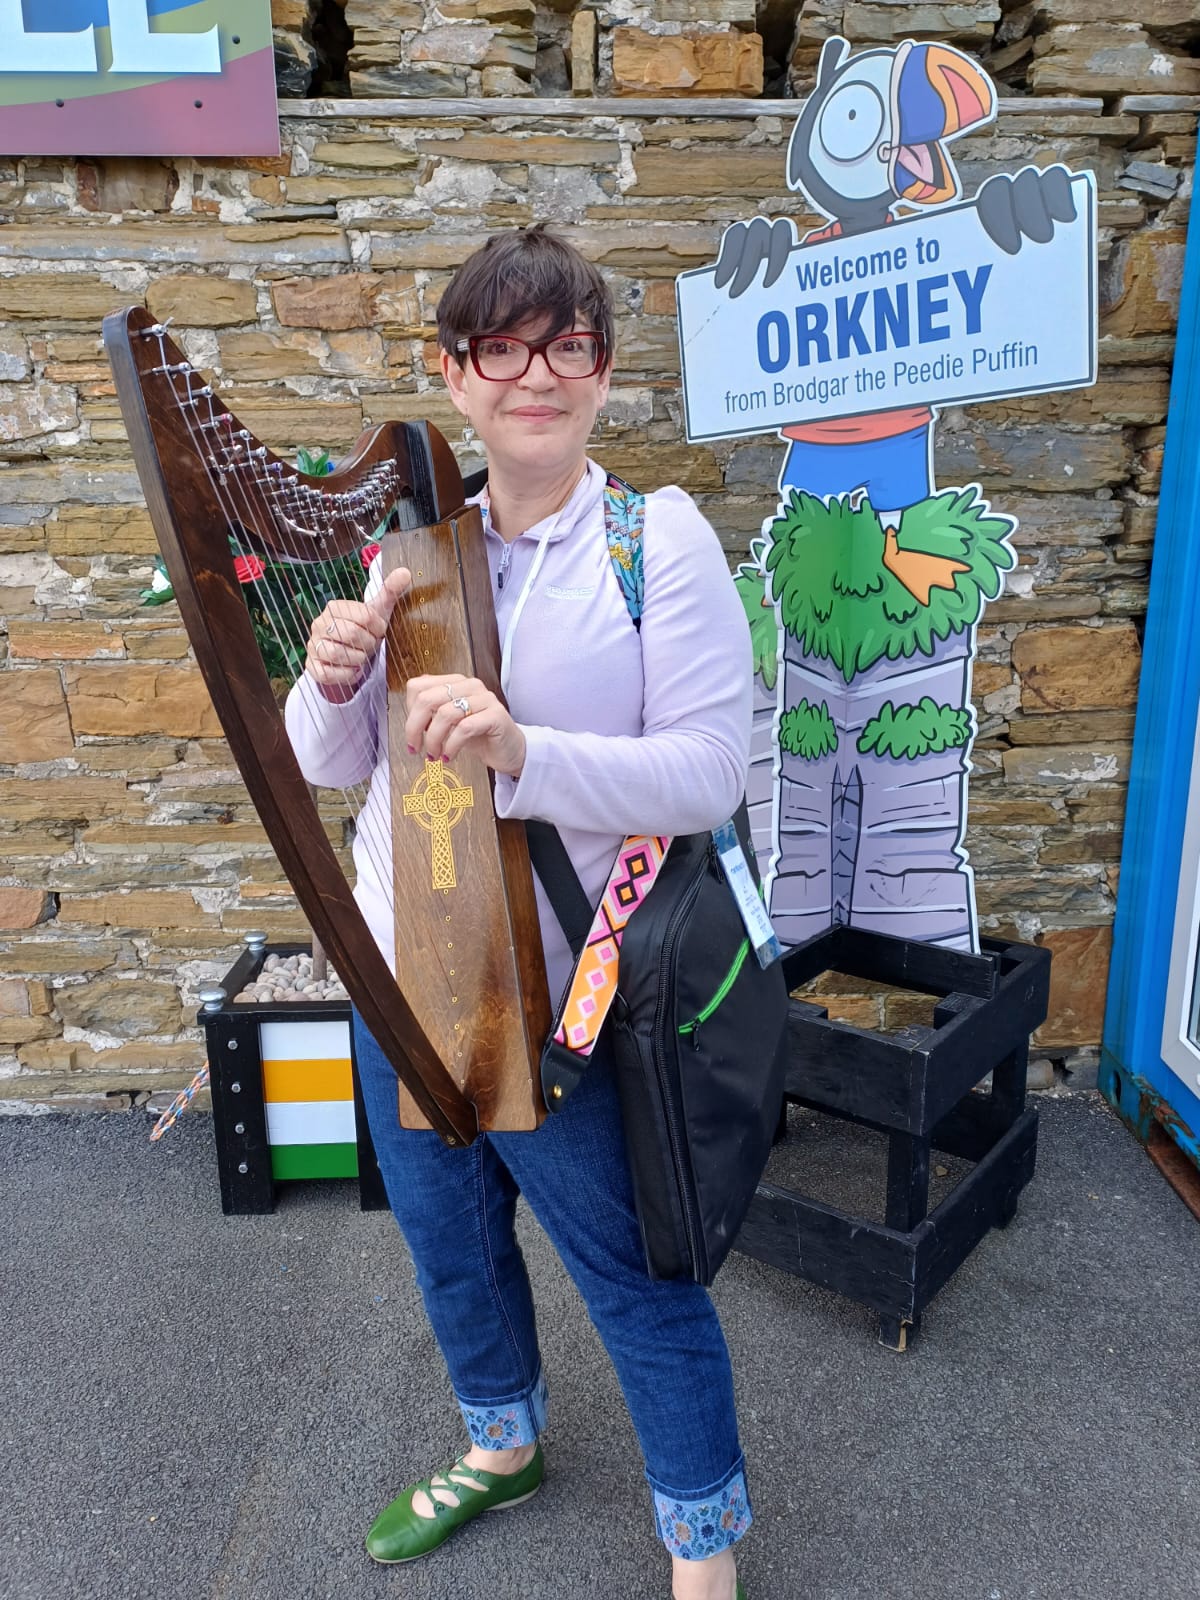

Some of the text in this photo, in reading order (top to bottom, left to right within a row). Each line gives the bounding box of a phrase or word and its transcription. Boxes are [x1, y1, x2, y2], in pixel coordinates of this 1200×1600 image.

[796, 237, 941, 292] Welcome to
[756, 263, 994, 375] ORKNEY
[724, 340, 1038, 414] from Brodgar the Peedie Puffin
